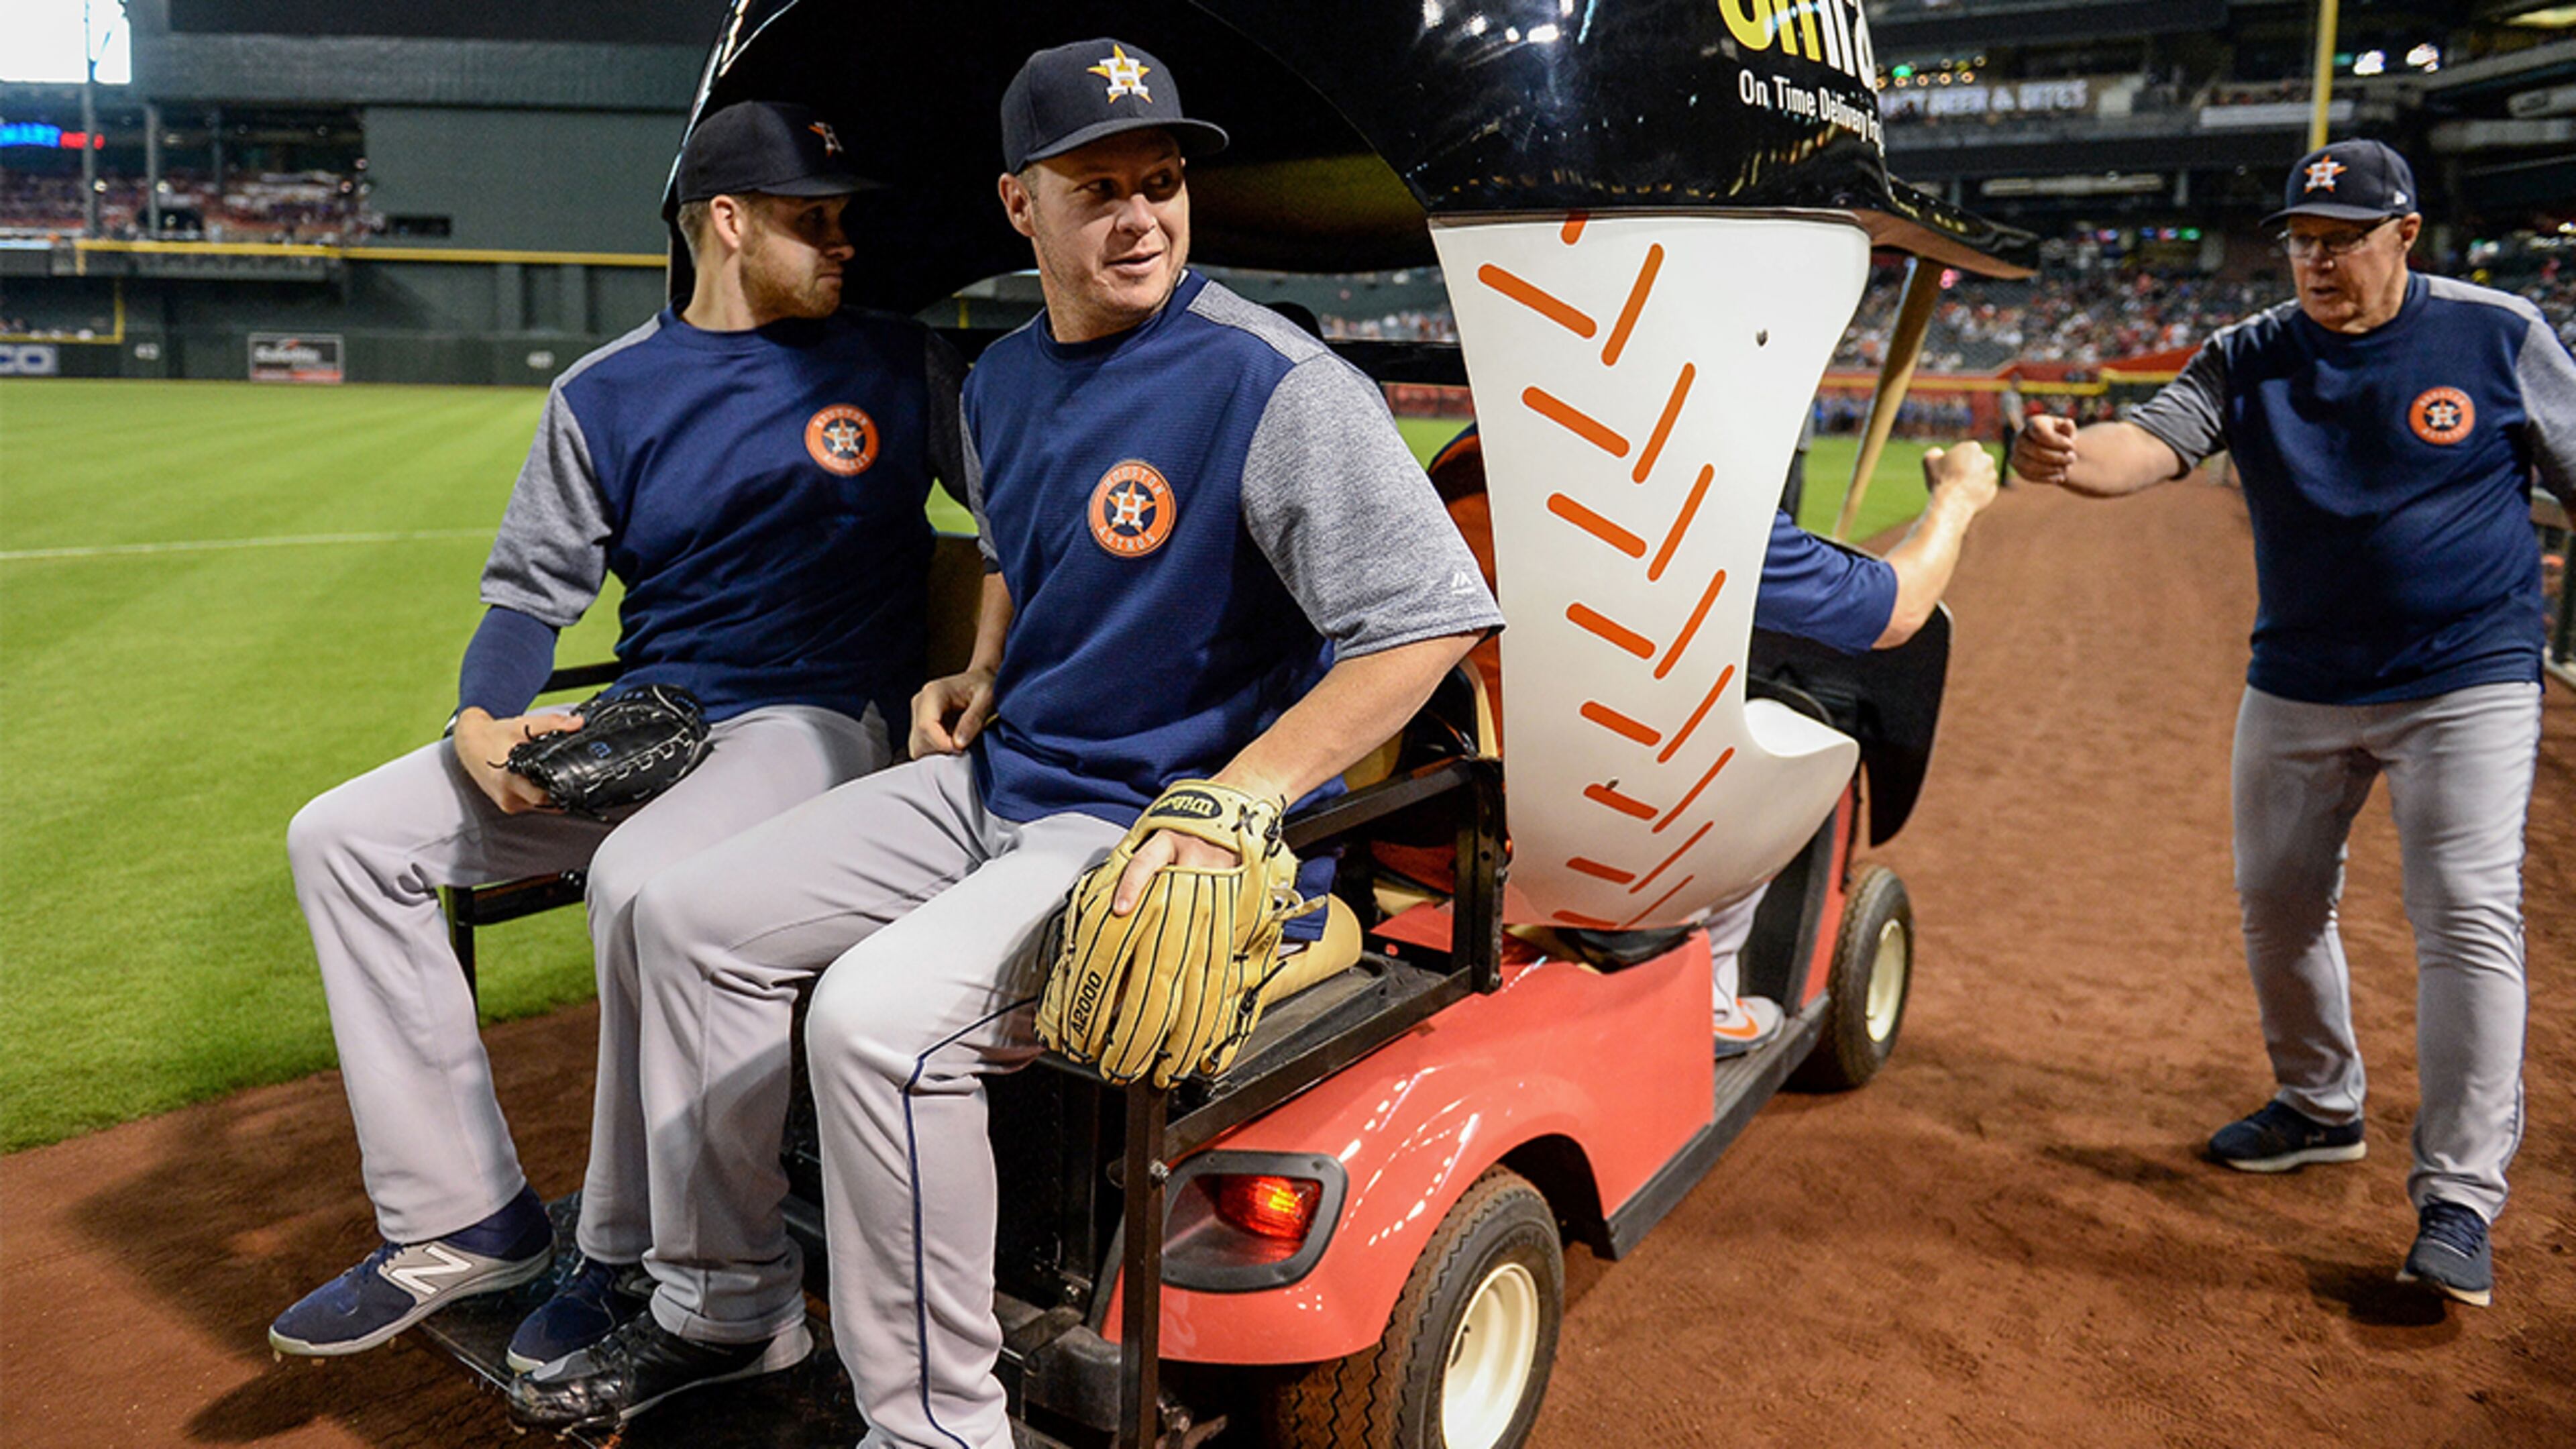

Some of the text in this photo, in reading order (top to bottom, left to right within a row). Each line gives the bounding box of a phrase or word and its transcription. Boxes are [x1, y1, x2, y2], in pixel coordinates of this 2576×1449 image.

[1099, 58, 1148, 95] H
[1739, 69, 1768, 106] On
[1772, 75, 1817, 117] Time
[2305, 161, 2339, 188] H
[829, 427, 859, 451] H
[1112, 491, 1146, 527] H
[1071, 971, 1102, 1038] A2000
